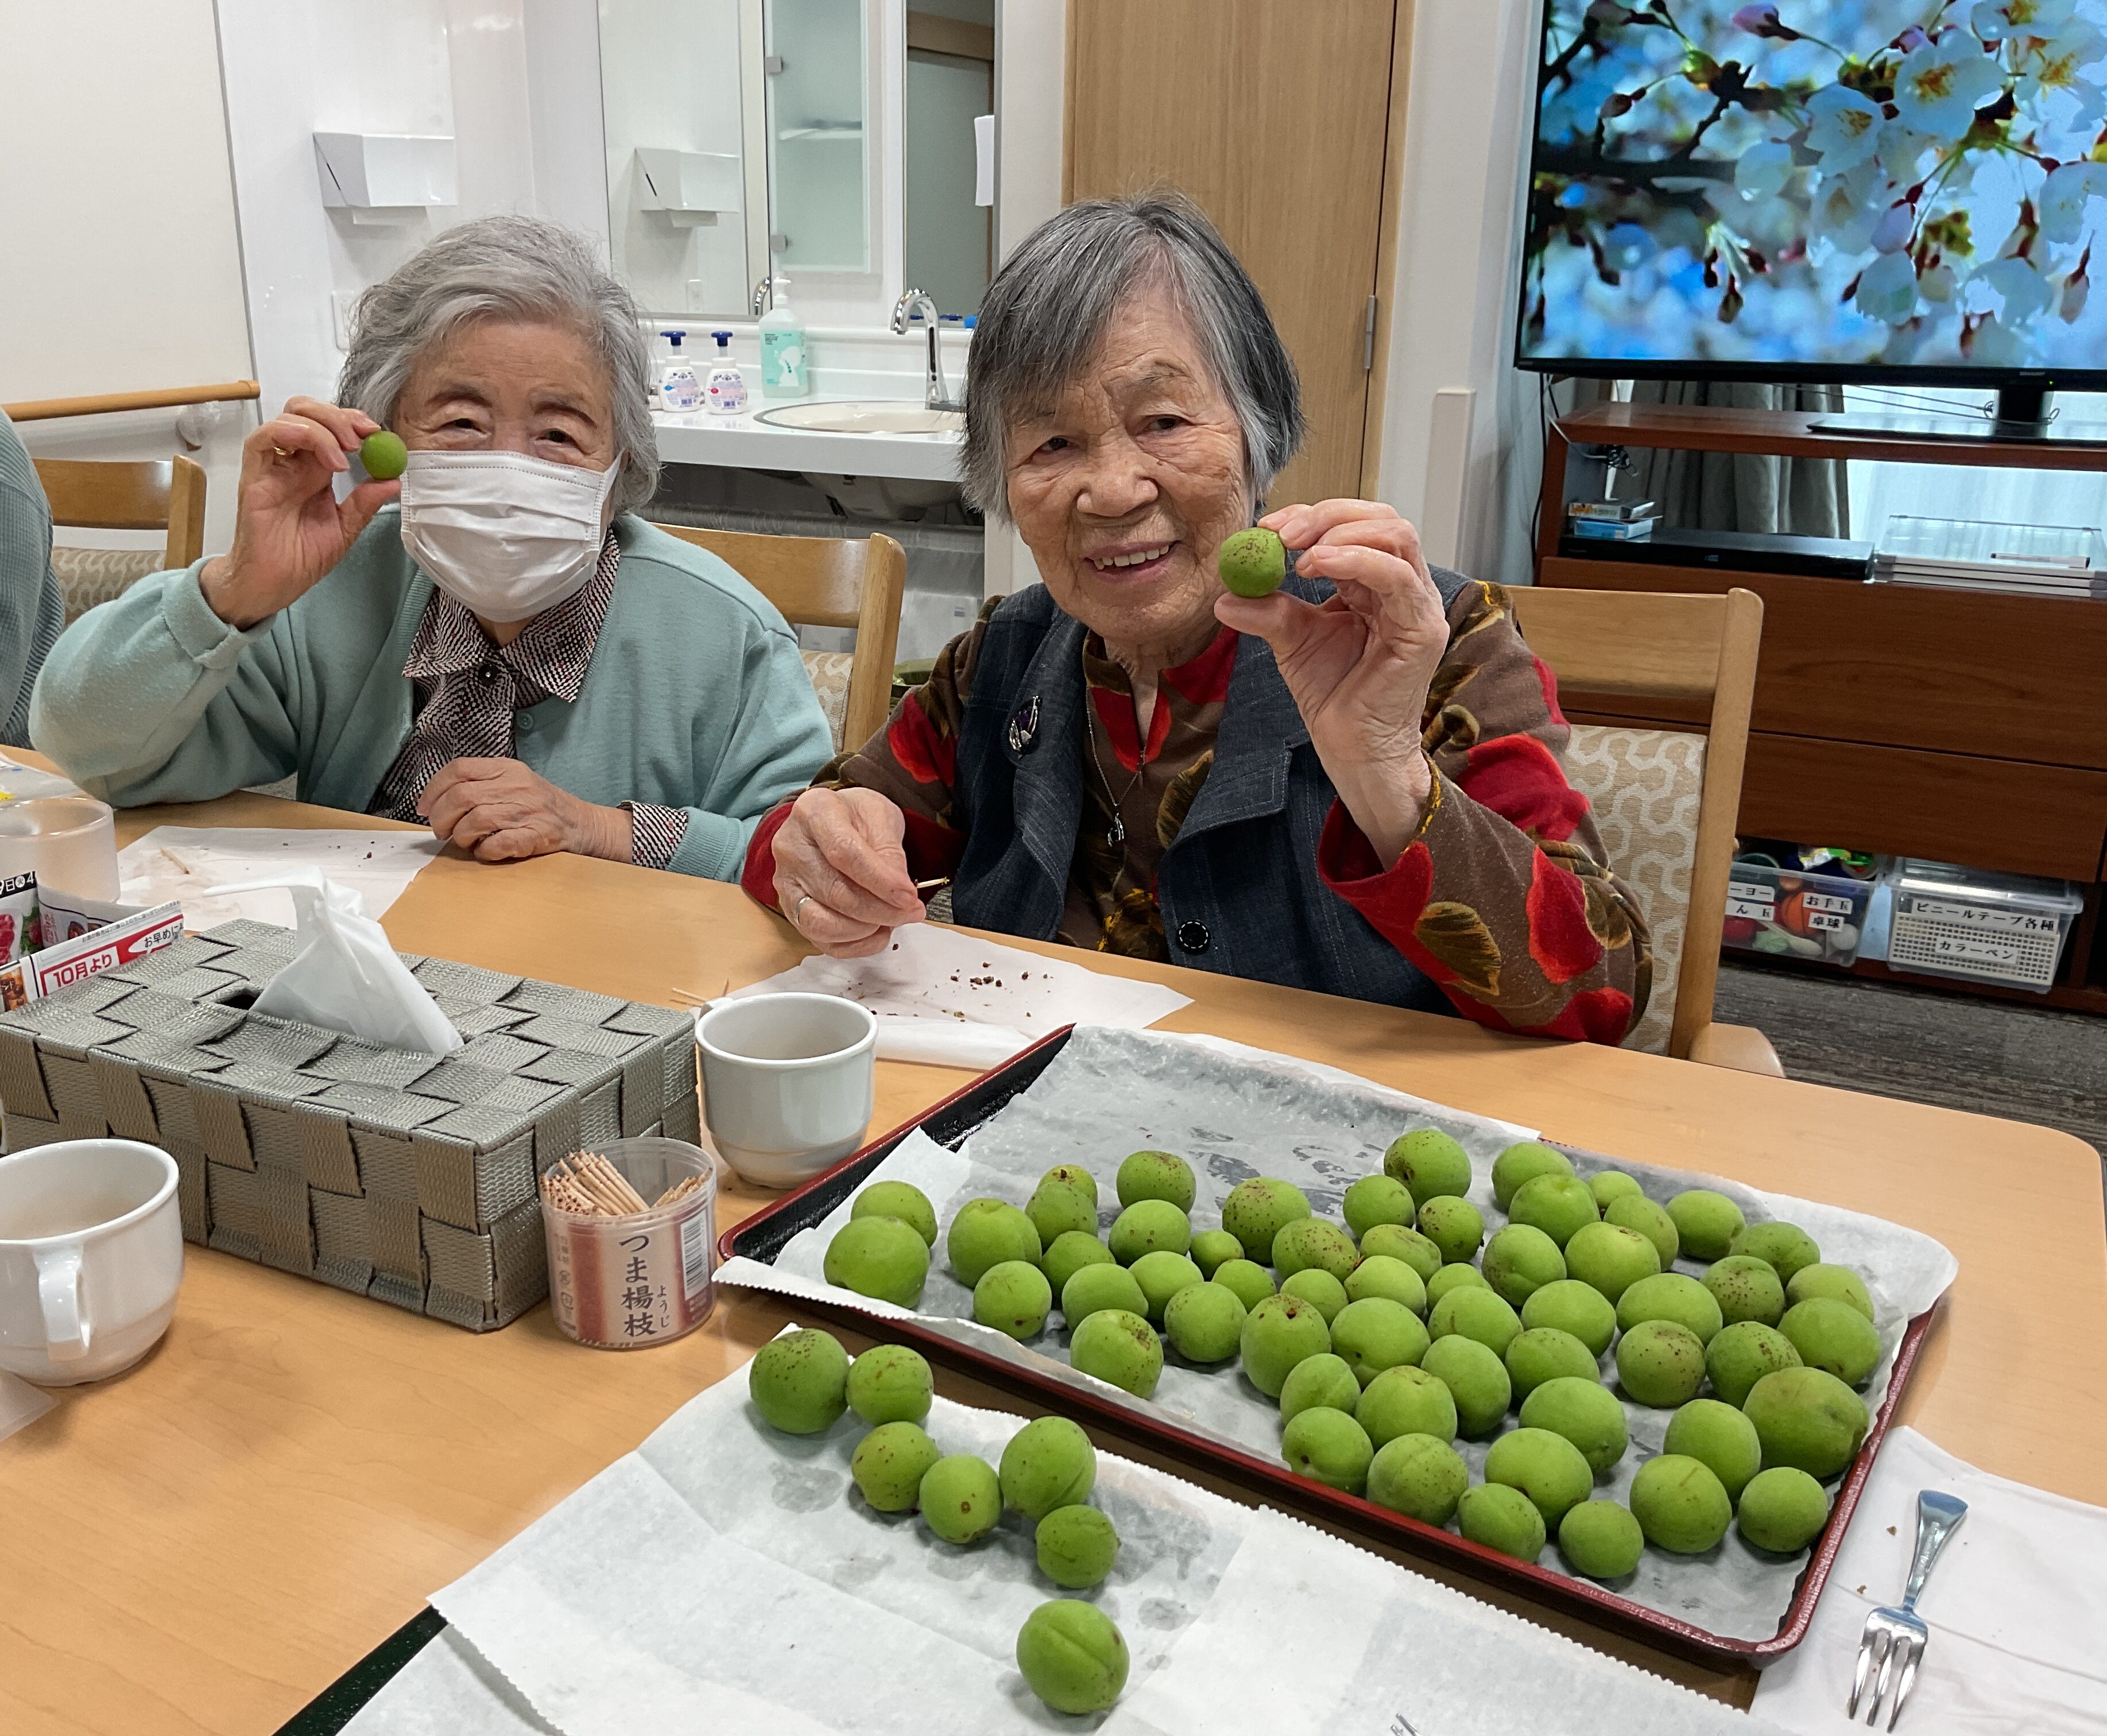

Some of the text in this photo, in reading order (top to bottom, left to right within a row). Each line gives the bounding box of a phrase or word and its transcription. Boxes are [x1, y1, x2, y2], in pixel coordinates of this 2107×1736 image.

[1916, 902, 2055, 931] ビニールテープ各種
[1939, 940, 2013, 959] カラーペン
[53, 954, 112, 987] 10月より
[619, 1235, 658, 1337] つま楊枝
[657, 1285, 670, 1328] ようじ
